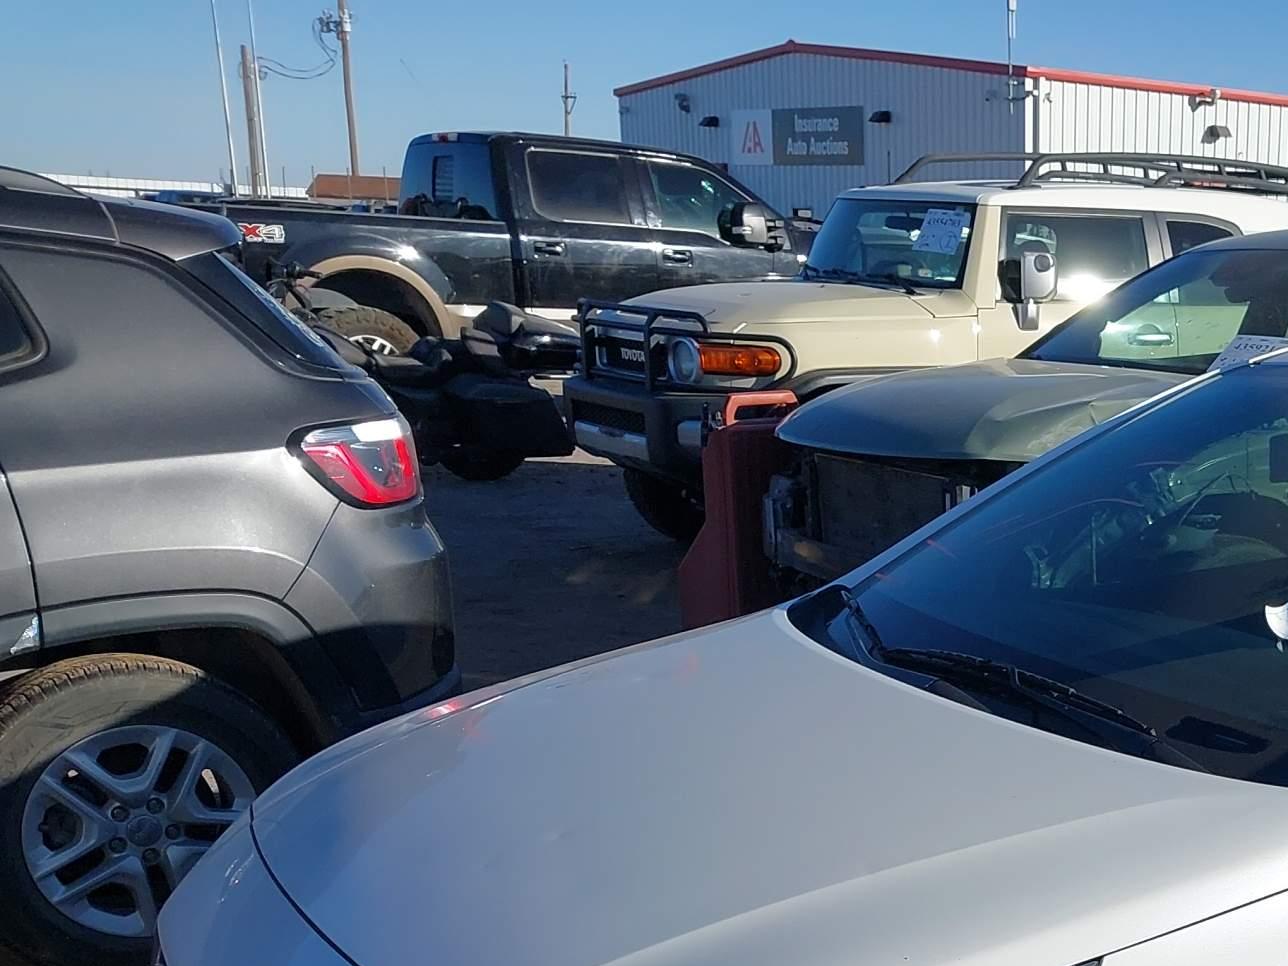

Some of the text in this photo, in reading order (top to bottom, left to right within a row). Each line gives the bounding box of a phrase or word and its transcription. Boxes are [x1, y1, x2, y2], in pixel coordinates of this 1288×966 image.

[794, 114, 839, 132] Insurance
[786, 136, 849, 155] Auto Auctions
[620, 347, 646, 362] TOYOTA
